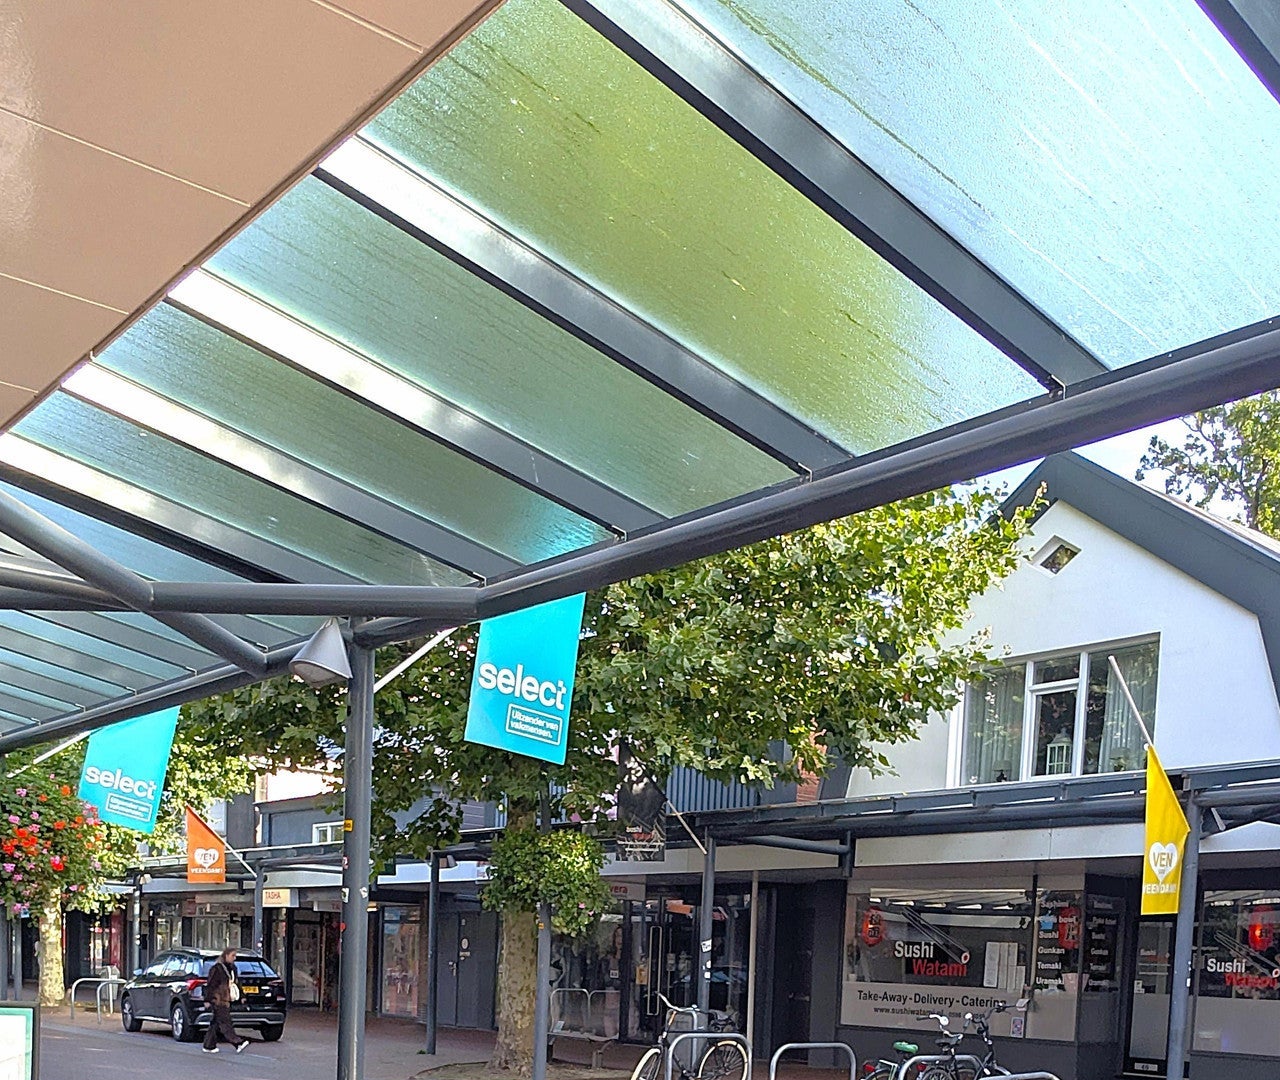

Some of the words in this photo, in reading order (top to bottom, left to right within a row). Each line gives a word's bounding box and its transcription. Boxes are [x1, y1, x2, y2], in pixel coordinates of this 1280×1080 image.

[478, 662, 567, 710] select
[85, 766, 157, 800] select
[1153, 852, 1173, 867] VEN
[264, 890, 282, 900] TASHA
[1038, 931, 1059, 939] Sushi
[894, 940, 934, 958] Sushi
[1038, 947, 1066, 955] Gunkan
[912, 959, 967, 977] Watami
[1037, 962, 1062, 970] Temaki
[1207, 959, 1246, 973] Sushi
[857, 990, 908, 1006] Take-Away
[913, 993, 955, 1008] Delivery
